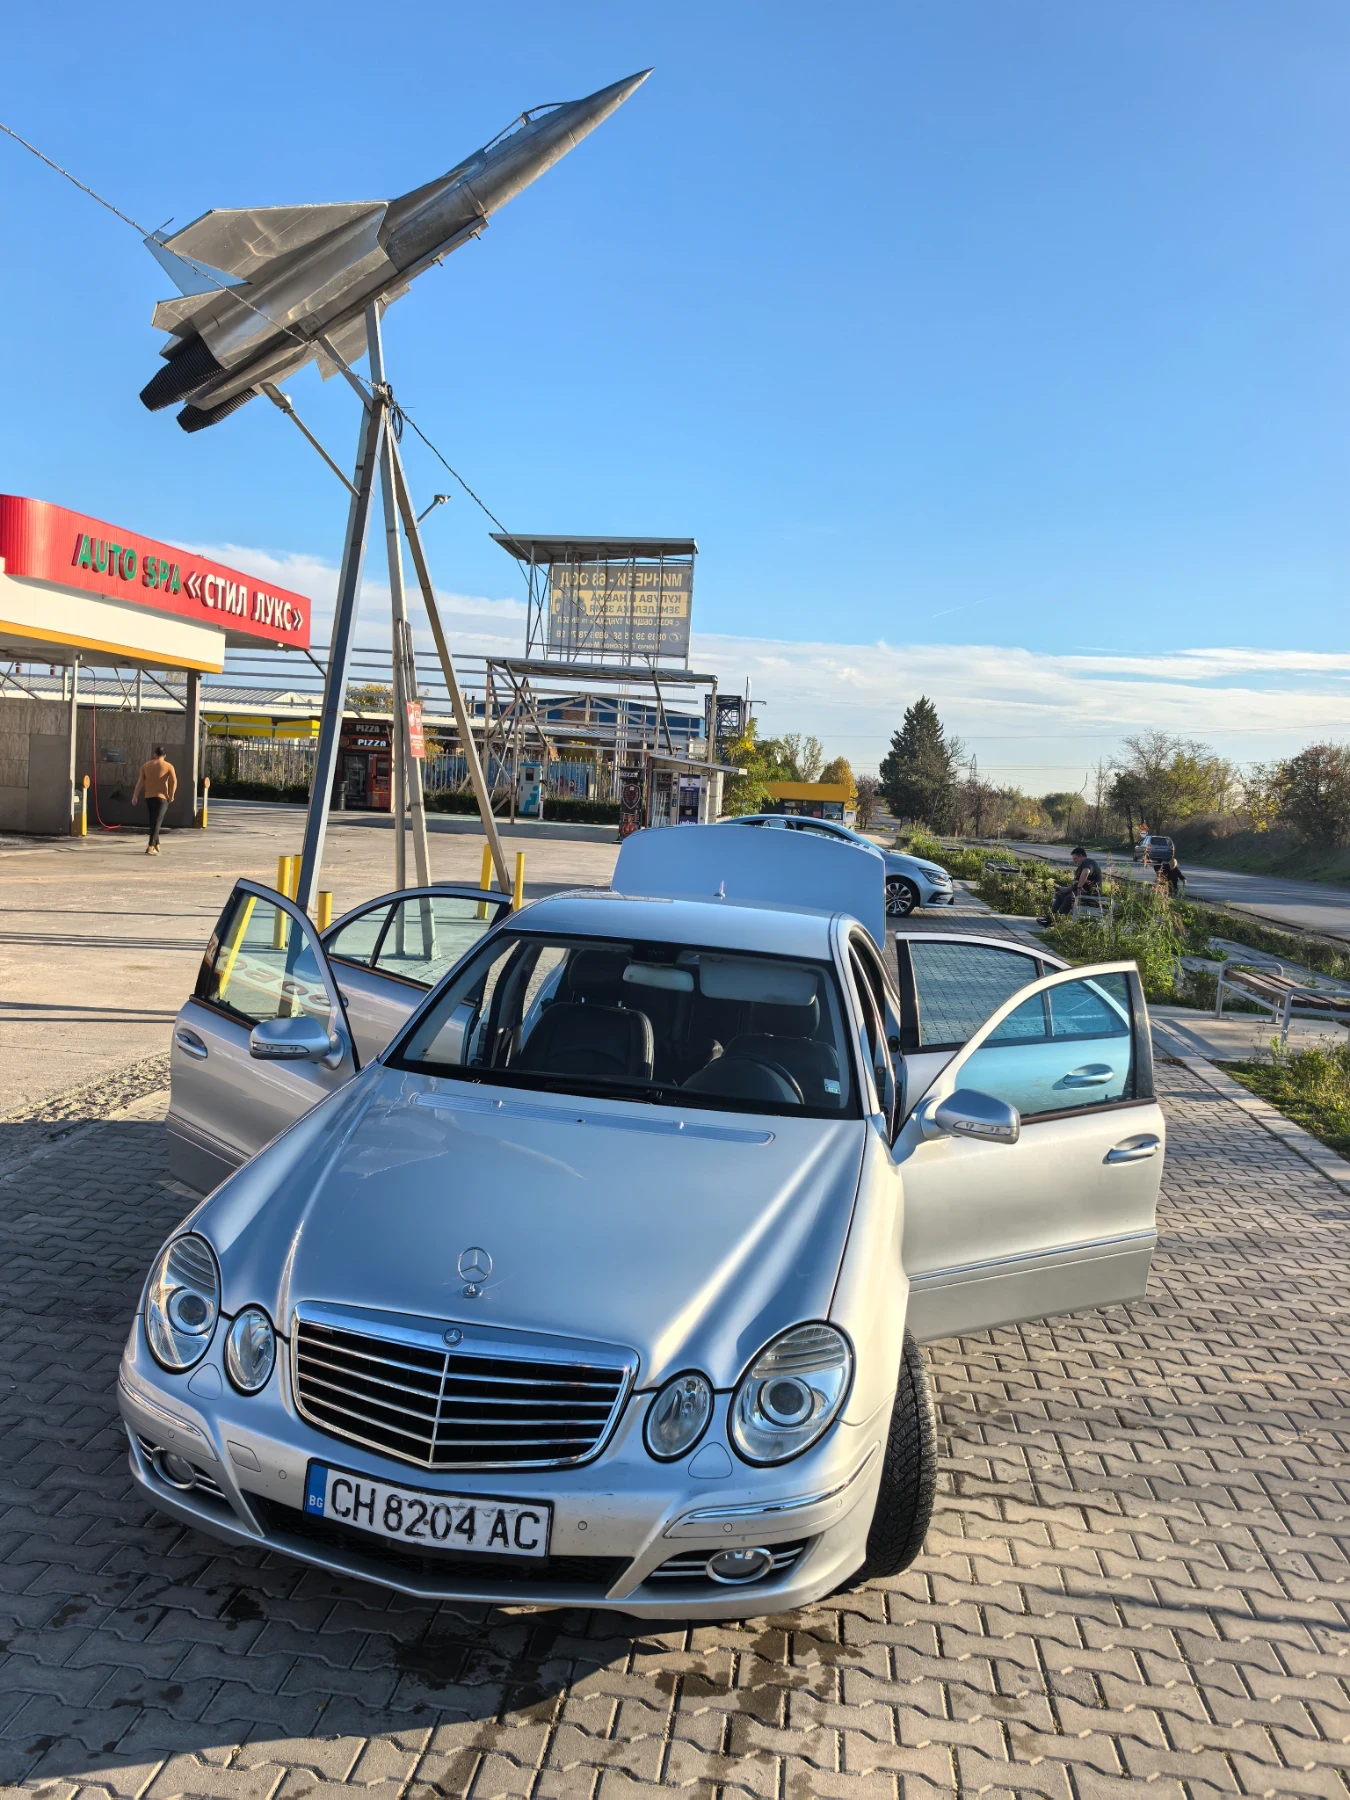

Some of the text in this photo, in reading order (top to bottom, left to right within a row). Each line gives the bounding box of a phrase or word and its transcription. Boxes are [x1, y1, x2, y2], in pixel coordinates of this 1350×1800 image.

[73, 534, 181, 595] AUTO SPA
[356, 724, 380, 733] PIZZA
[357, 738, 387, 747] PIZZA
[309, 1494, 324, 1508] BG
[331, 1478, 541, 1550] CH 8204 AC
